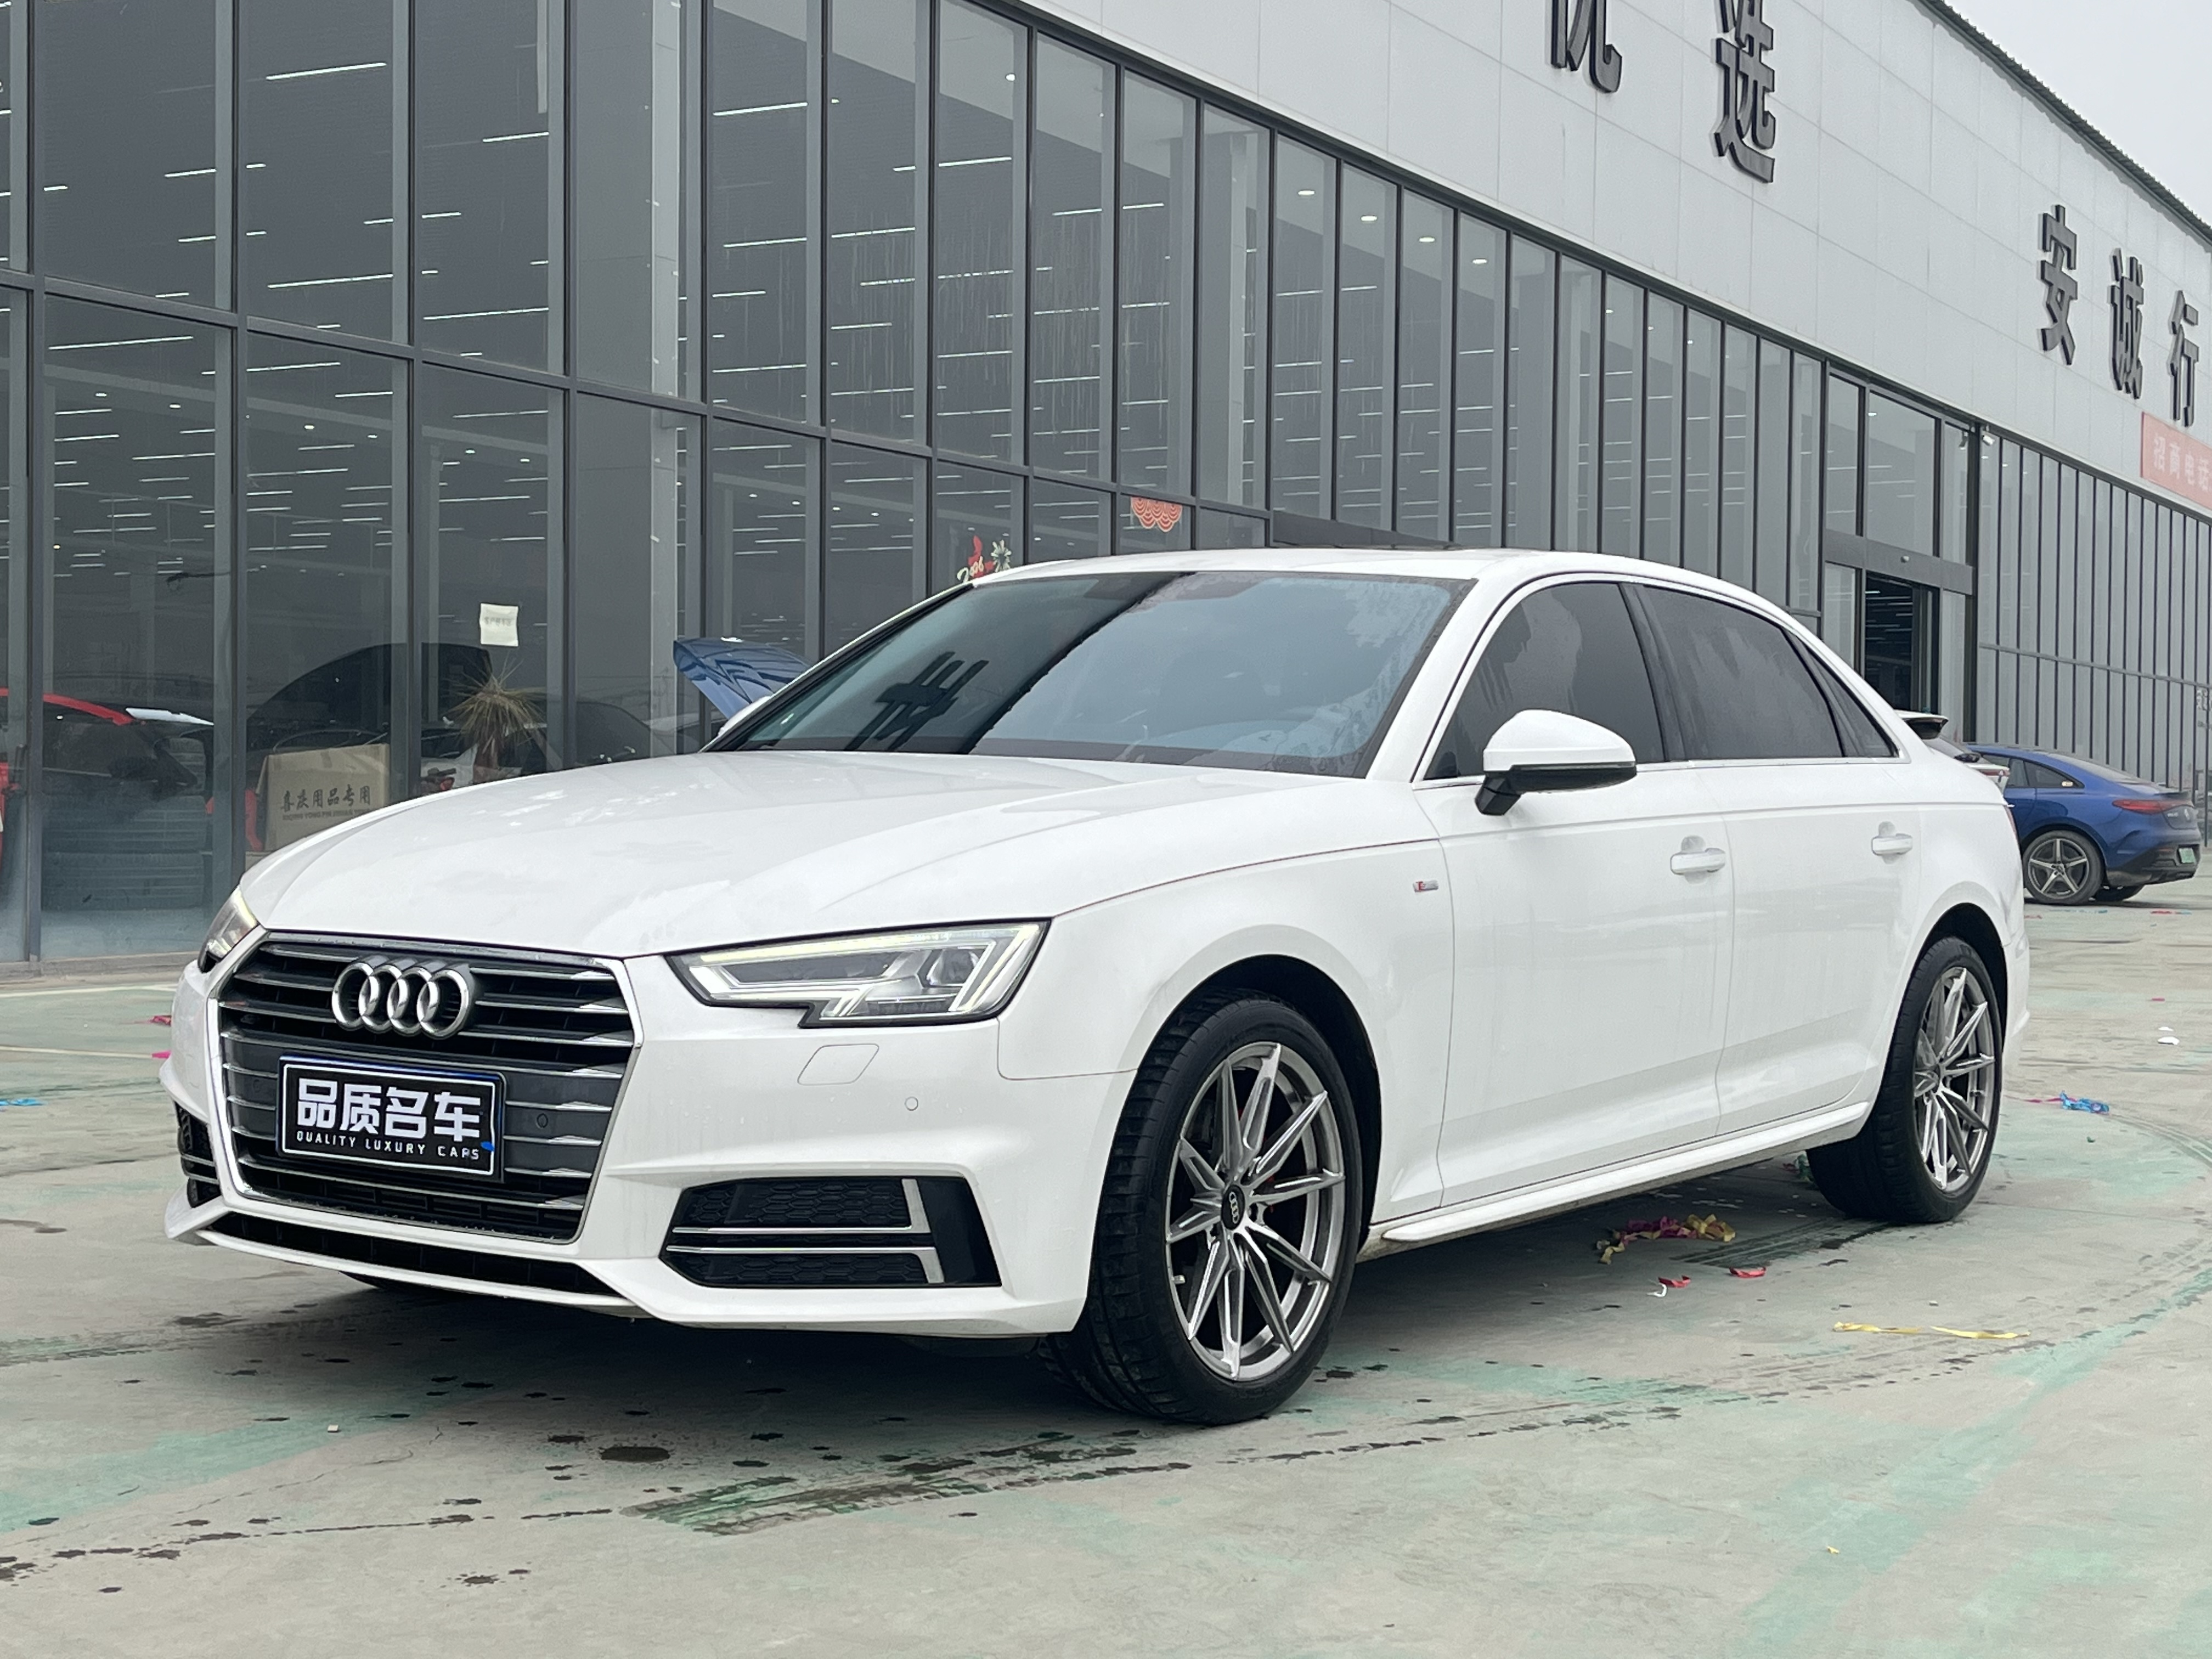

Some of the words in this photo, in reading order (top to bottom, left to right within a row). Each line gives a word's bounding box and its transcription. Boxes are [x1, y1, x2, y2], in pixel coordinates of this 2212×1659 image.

[2040, 204, 2199, 428] 安诚行
[297, 1077, 481, 1142] 品质名车
[297, 1131, 356, 1147] QUALITY
[365, 1138, 425, 1155] LUXURY
[438, 1146, 479, 1160] CARS
